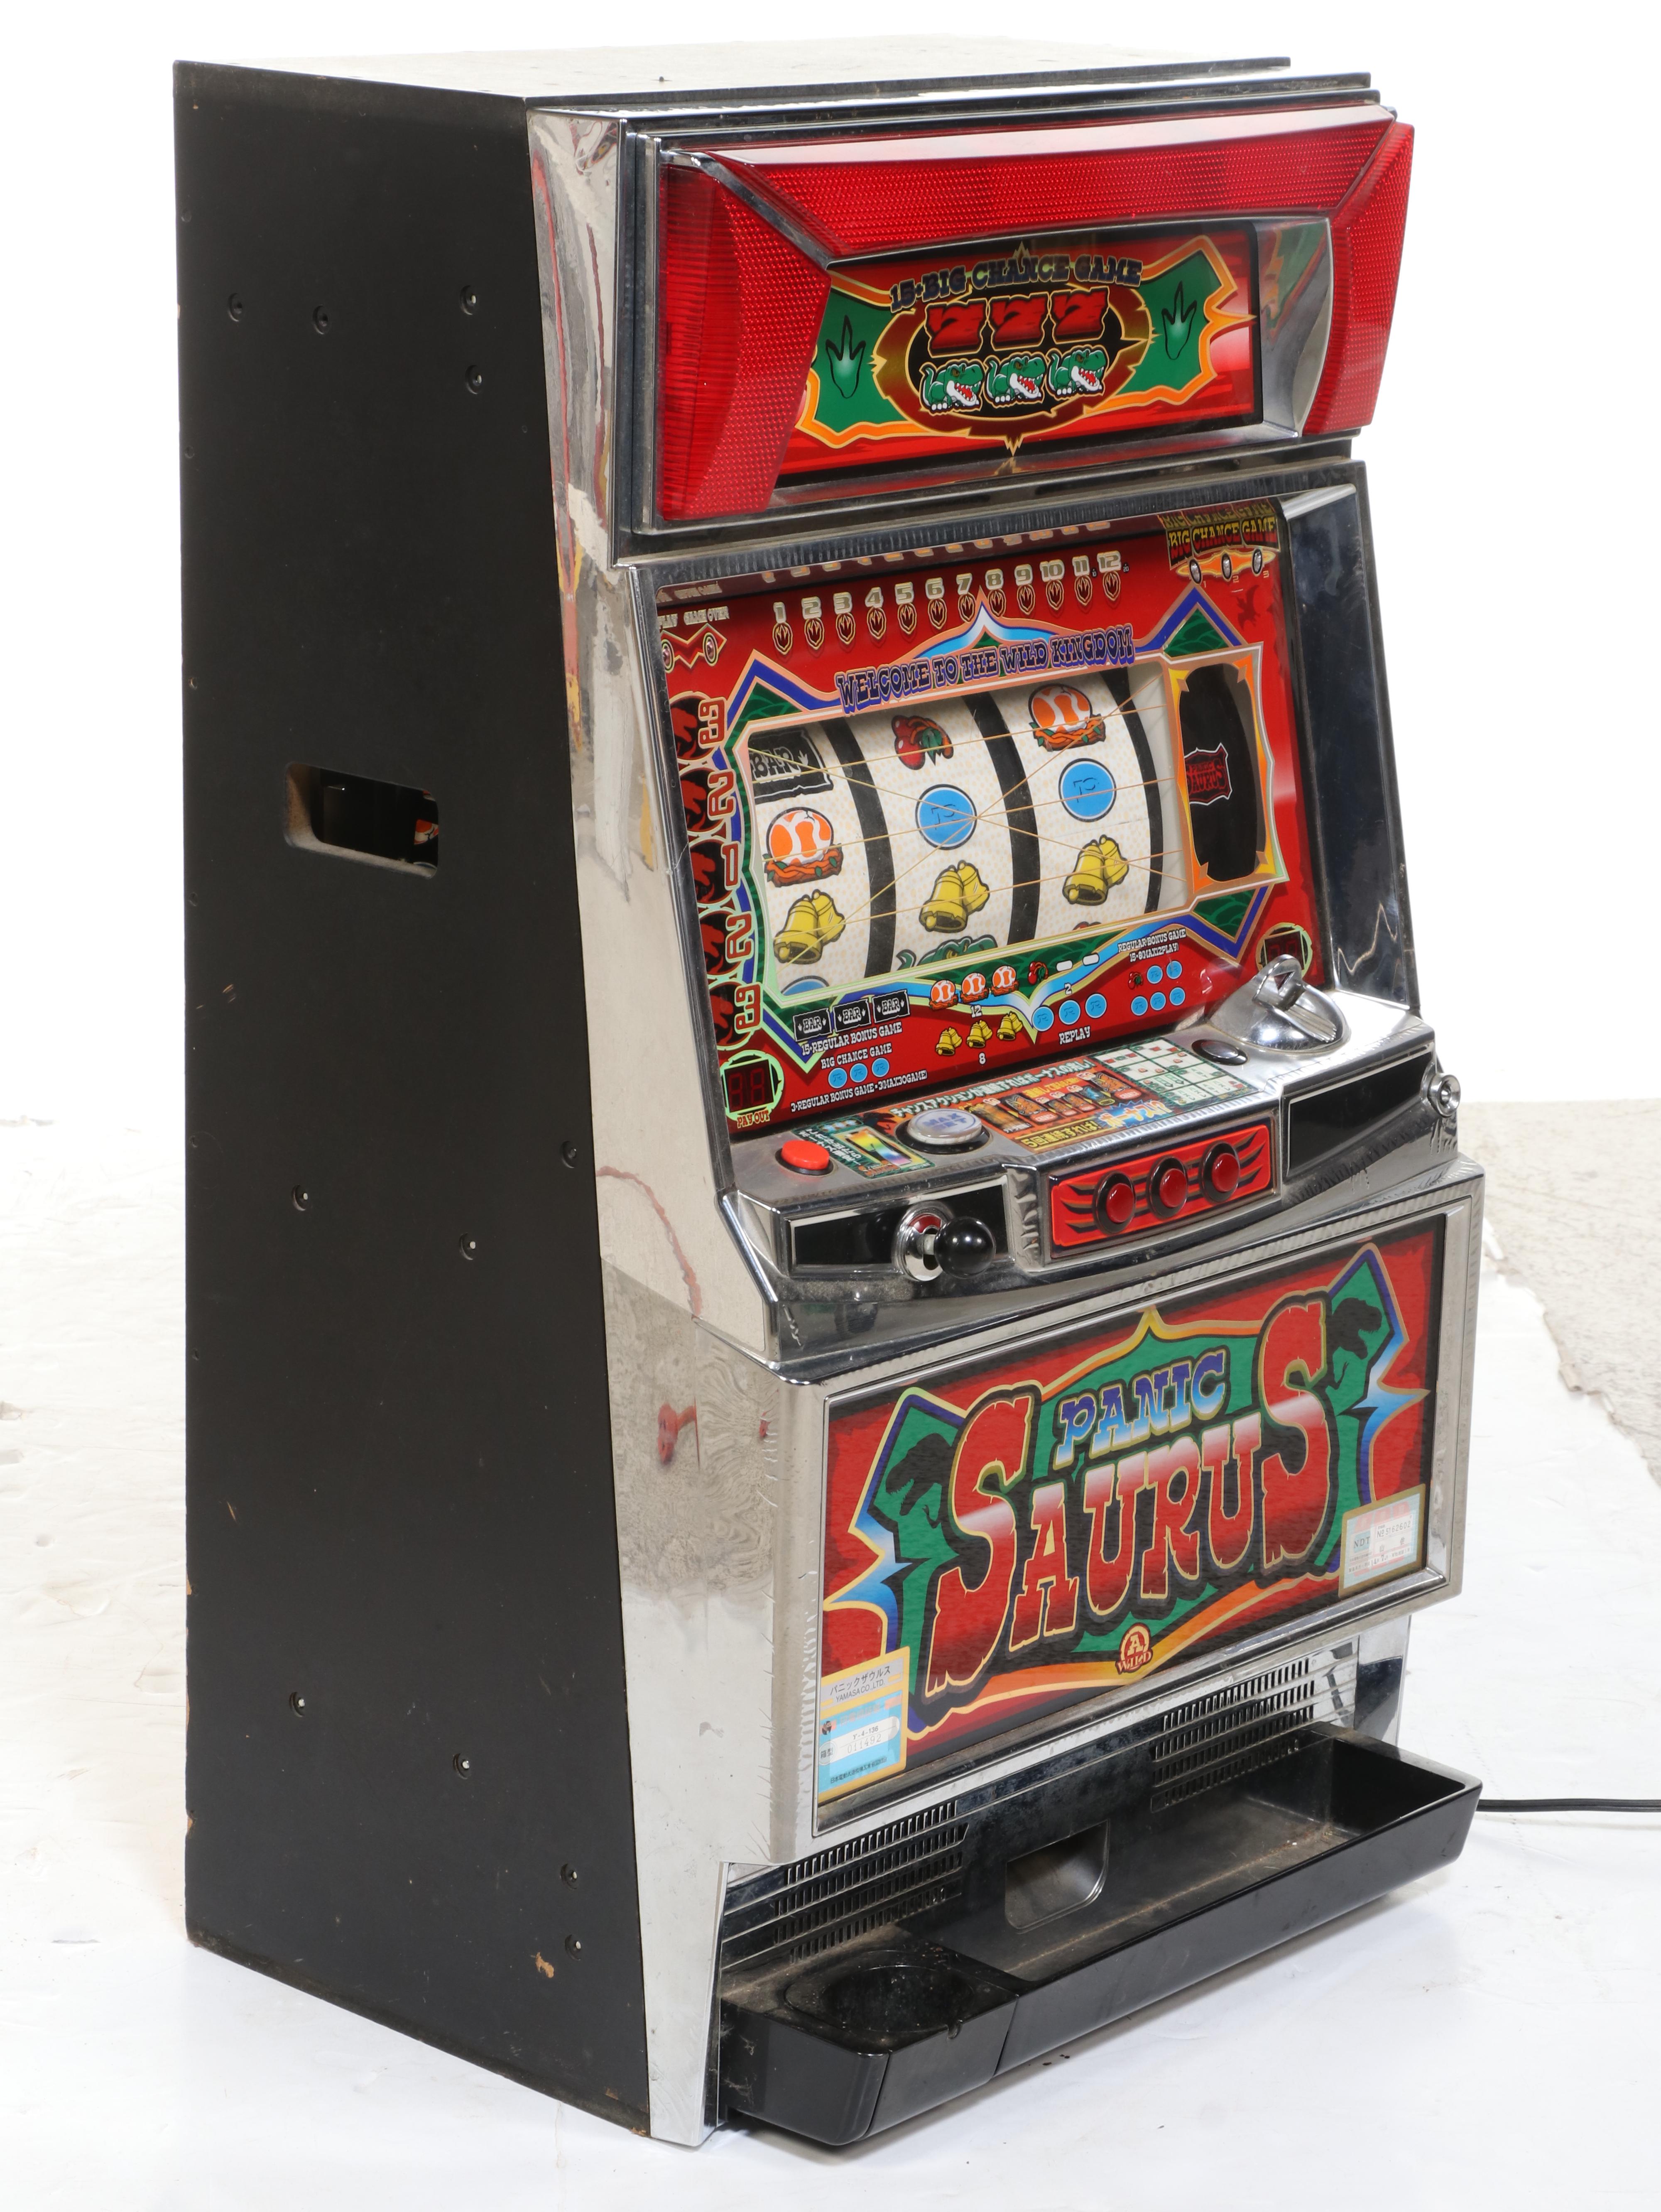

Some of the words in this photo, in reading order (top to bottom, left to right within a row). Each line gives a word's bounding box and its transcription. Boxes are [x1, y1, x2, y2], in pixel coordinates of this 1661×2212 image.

[972, 254, 1070, 289] CHANCE
[1074, 254, 1143, 287] GAME
[1169, 530, 1191, 559] BIG
[1193, 521, 1241, 554] CHANCE
[1242, 516, 1278, 543] GAME
[773, 602, 786, 623] 1
[801, 596, 823, 619] 2
[833, 592, 852, 614] 3
[865, 587, 884, 608] 4
[894, 582, 914, 604] 5
[925, 577, 945, 599] 6
[956, 573, 973, 595] 7
[985, 568, 1004, 590] 8
[1014, 564, 1033, 586] 9
[1040, 559, 1065, 582] 10
[1072, 555, 1090, 576] 11
[1097, 551, 1121, 573] 12
[835, 660, 931, 711] WELCOME
[933, 655, 958, 687] TO
[961, 649, 997, 681] THE
[1000, 641, 1049, 673] WILD
[1050, 625, 1135, 668] KINGDOM
[698, 697, 727, 748] 3
[708, 769, 736, 820] 2
[721, 842, 740, 888] 1
[726, 913, 754, 965] 2
[1118, 938, 1147, 952] REGULAR
[1147, 933, 1168, 946] BONUS
[1168, 929, 1186, 941] GAME
[1064, 983, 1072, 995] 2
[735, 983, 763, 1033] 3
[803, 1016, 822, 1033] BAR
[843, 1007, 862, 1024] BAR
[882, 998, 900, 1015] BAR
[971, 1005, 982, 1018] 12
[850, 1028, 877, 1043] BONUS
[879, 1022, 902, 1037] GAME
[1059, 1026, 1091, 1045] REPLAY
[821, 1057, 835, 1069] BIG
[837, 1049, 868, 1065] CHANCE
[870, 1043, 892, 1057] GAME
[978, 1053, 986, 1064] 8
[830, 1089, 853, 1102] BONUS
[737, 1113, 753, 1128] PAY
[753, 1109, 770, 1124] OUT
[1053, 1348, 1226, 1470] PANIC
[925, 1301, 1330, 1697] SAURUS
[1386, 1520, 1411, 1535] 5162602
[1354, 1537, 1370, 1549] NDT
[830, 1666, 890, 1696] パニックザウルス
[835, 1688, 861, 1702] YAMASA
[848, 1733, 882, 1754] 011492
